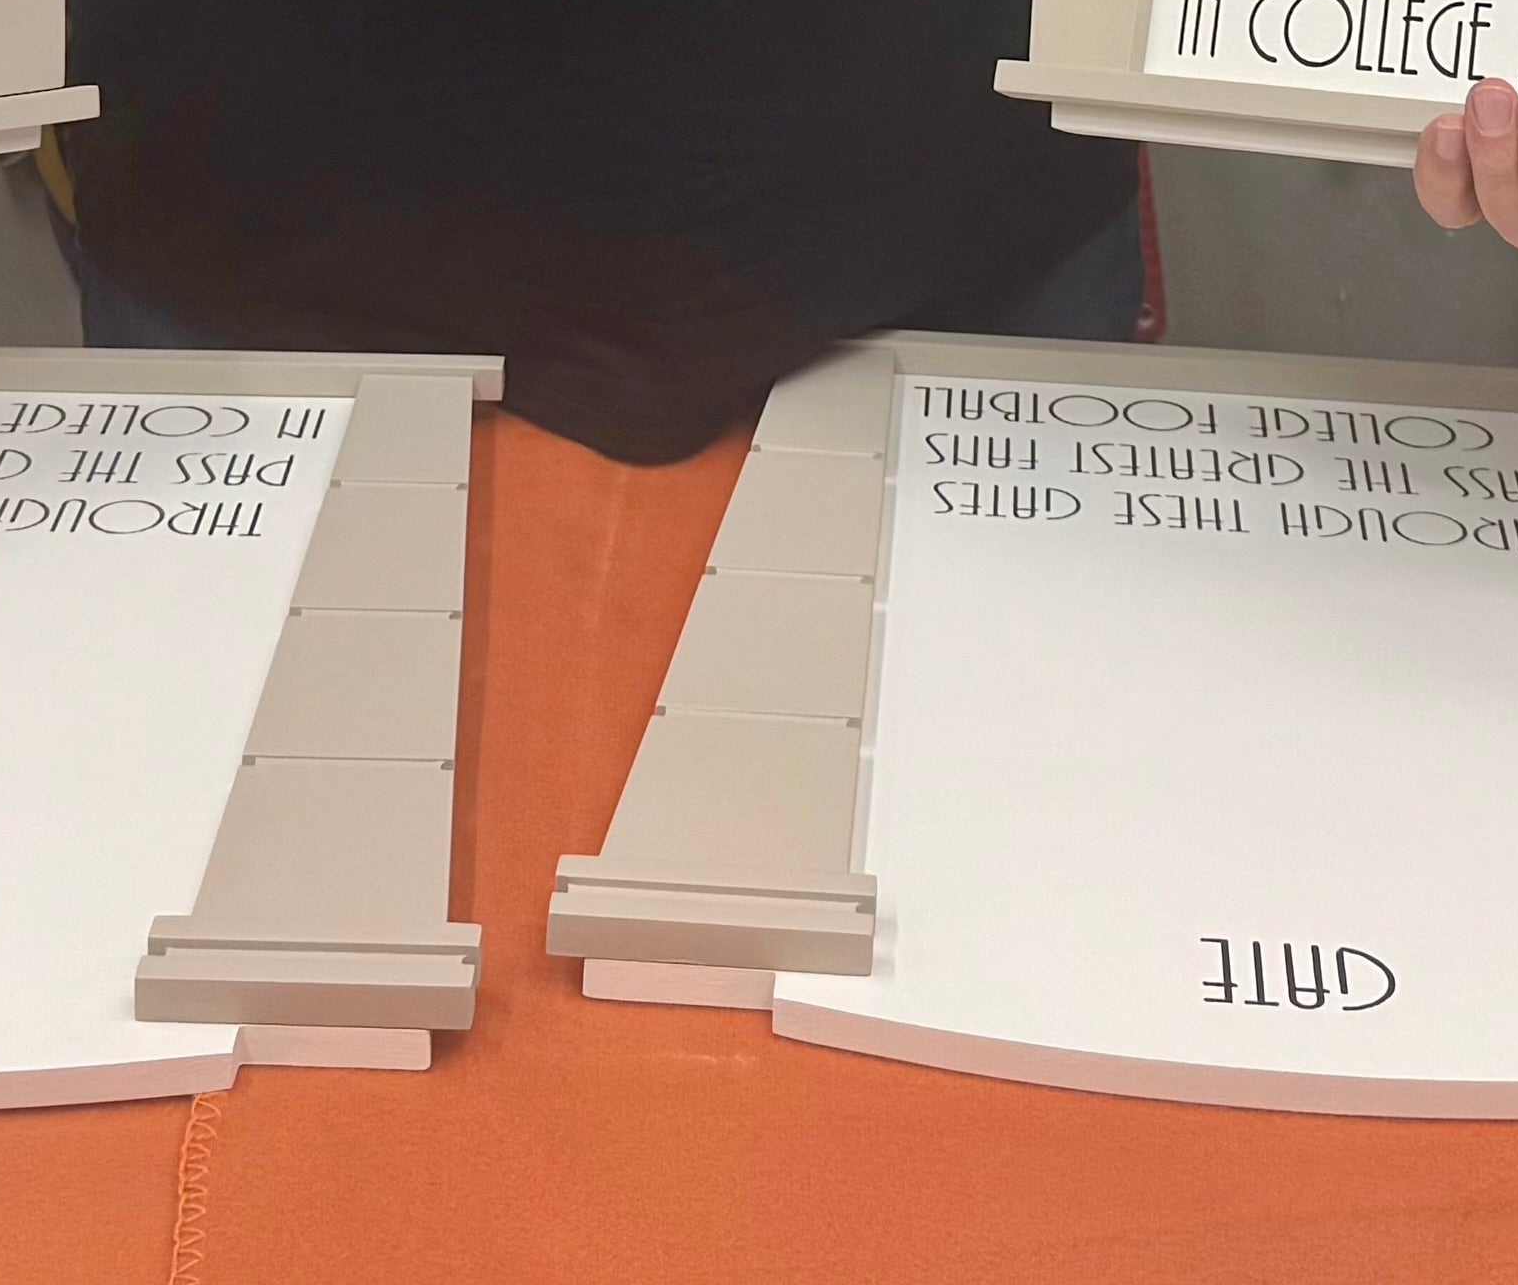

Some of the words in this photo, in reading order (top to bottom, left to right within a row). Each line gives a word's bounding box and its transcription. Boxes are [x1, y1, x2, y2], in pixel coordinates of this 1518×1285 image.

[277, 408, 325, 439] IN
[915, 387, 1216, 434] FOOTBALL
[1248, 406, 1493, 449] COLLEGE
[59, 450, 142, 483] THE
[176, 453, 294, 486] PASS
[925, 433, 1038, 470] FANS
[1069, 442, 1304, 485] GREATEST
[1335, 458, 1418, 494] THE
[934, 481, 1081, 520] GATES
[1114, 492, 1250, 533] THESE
[1200, 938, 1396, 1011] GATE
